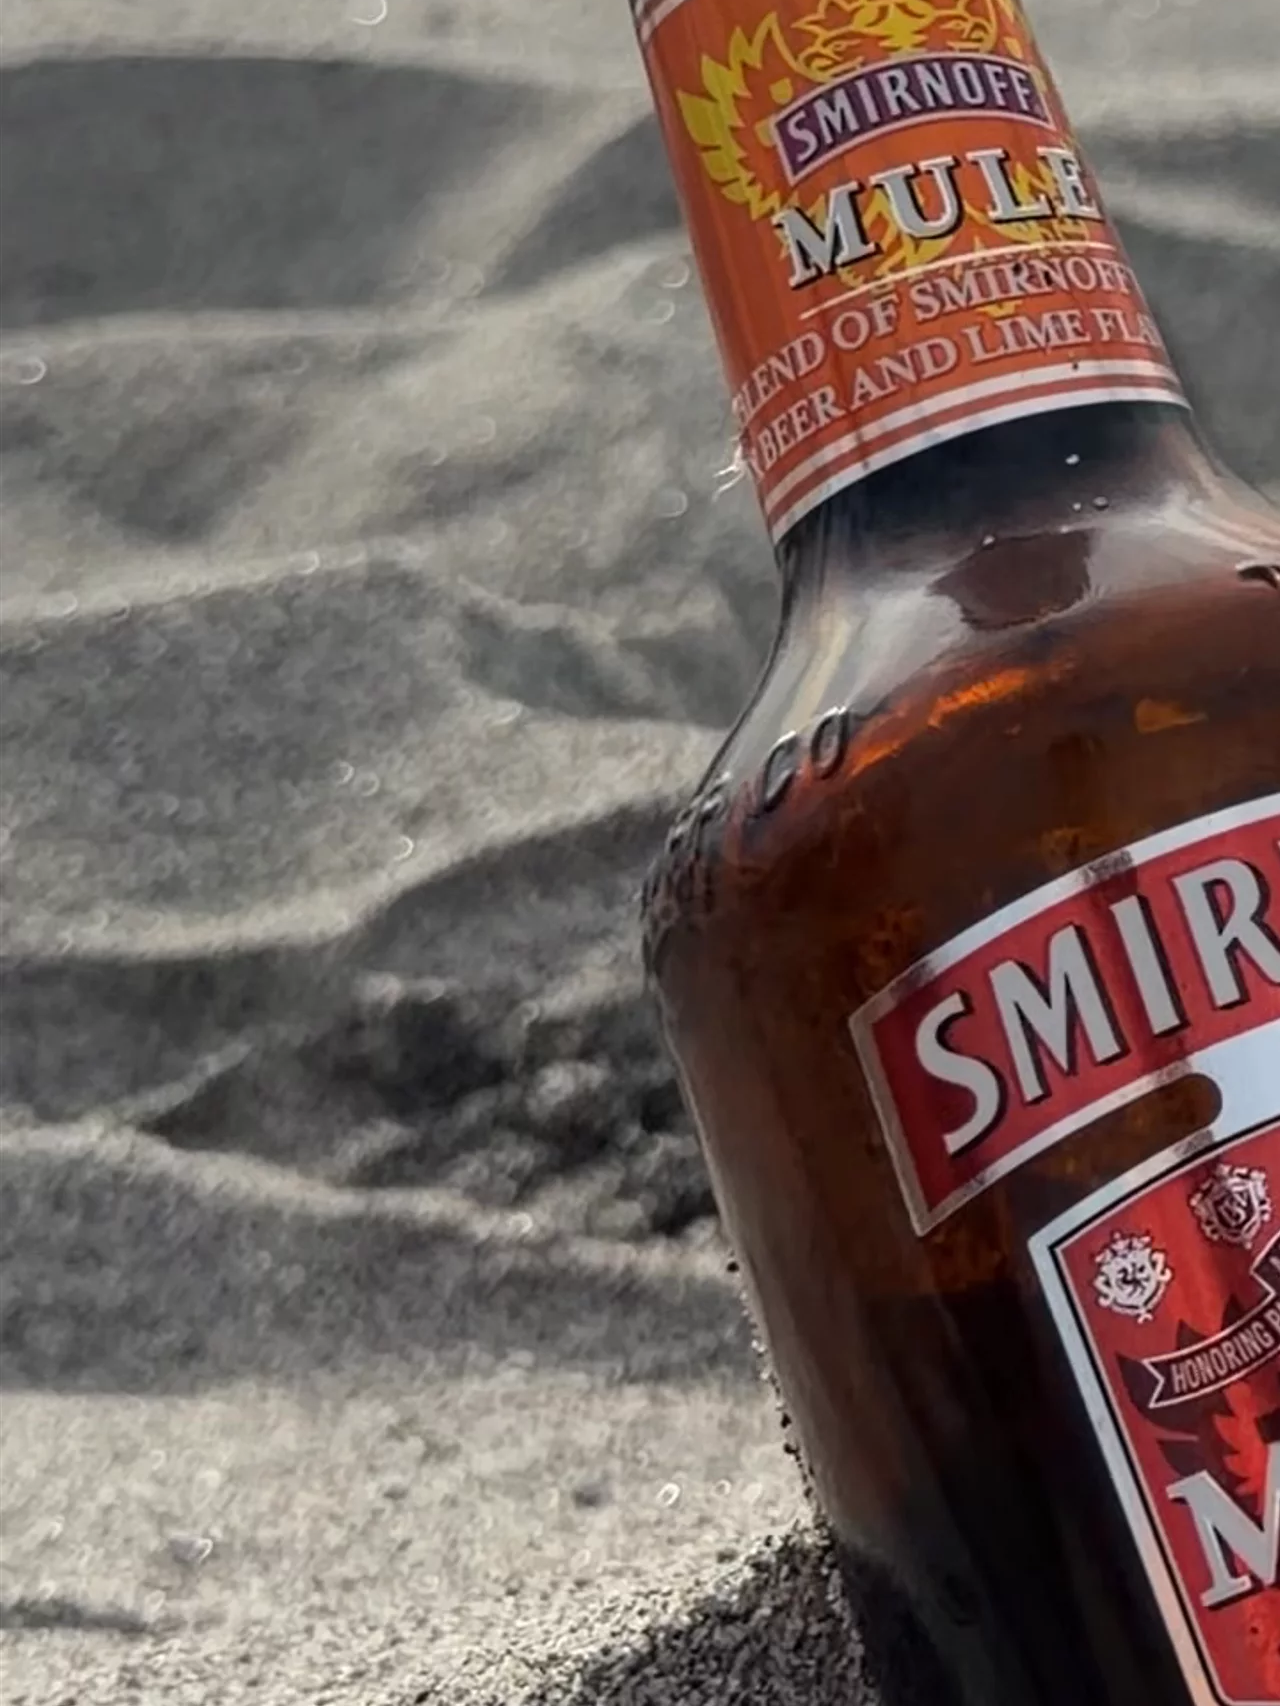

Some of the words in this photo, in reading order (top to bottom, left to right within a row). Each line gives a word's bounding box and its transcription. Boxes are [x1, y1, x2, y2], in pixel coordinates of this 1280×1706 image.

[787, 60, 1039, 170] SMIRNOFF
[772, 146, 1104, 290] MULE
[831, 294, 899, 350] OF
[757, 384, 847, 471] BEER
[851, 337, 958, 408] AND
[965, 308, 1091, 362] LIME
[1171, 1320, 1275, 1393] HONORING
